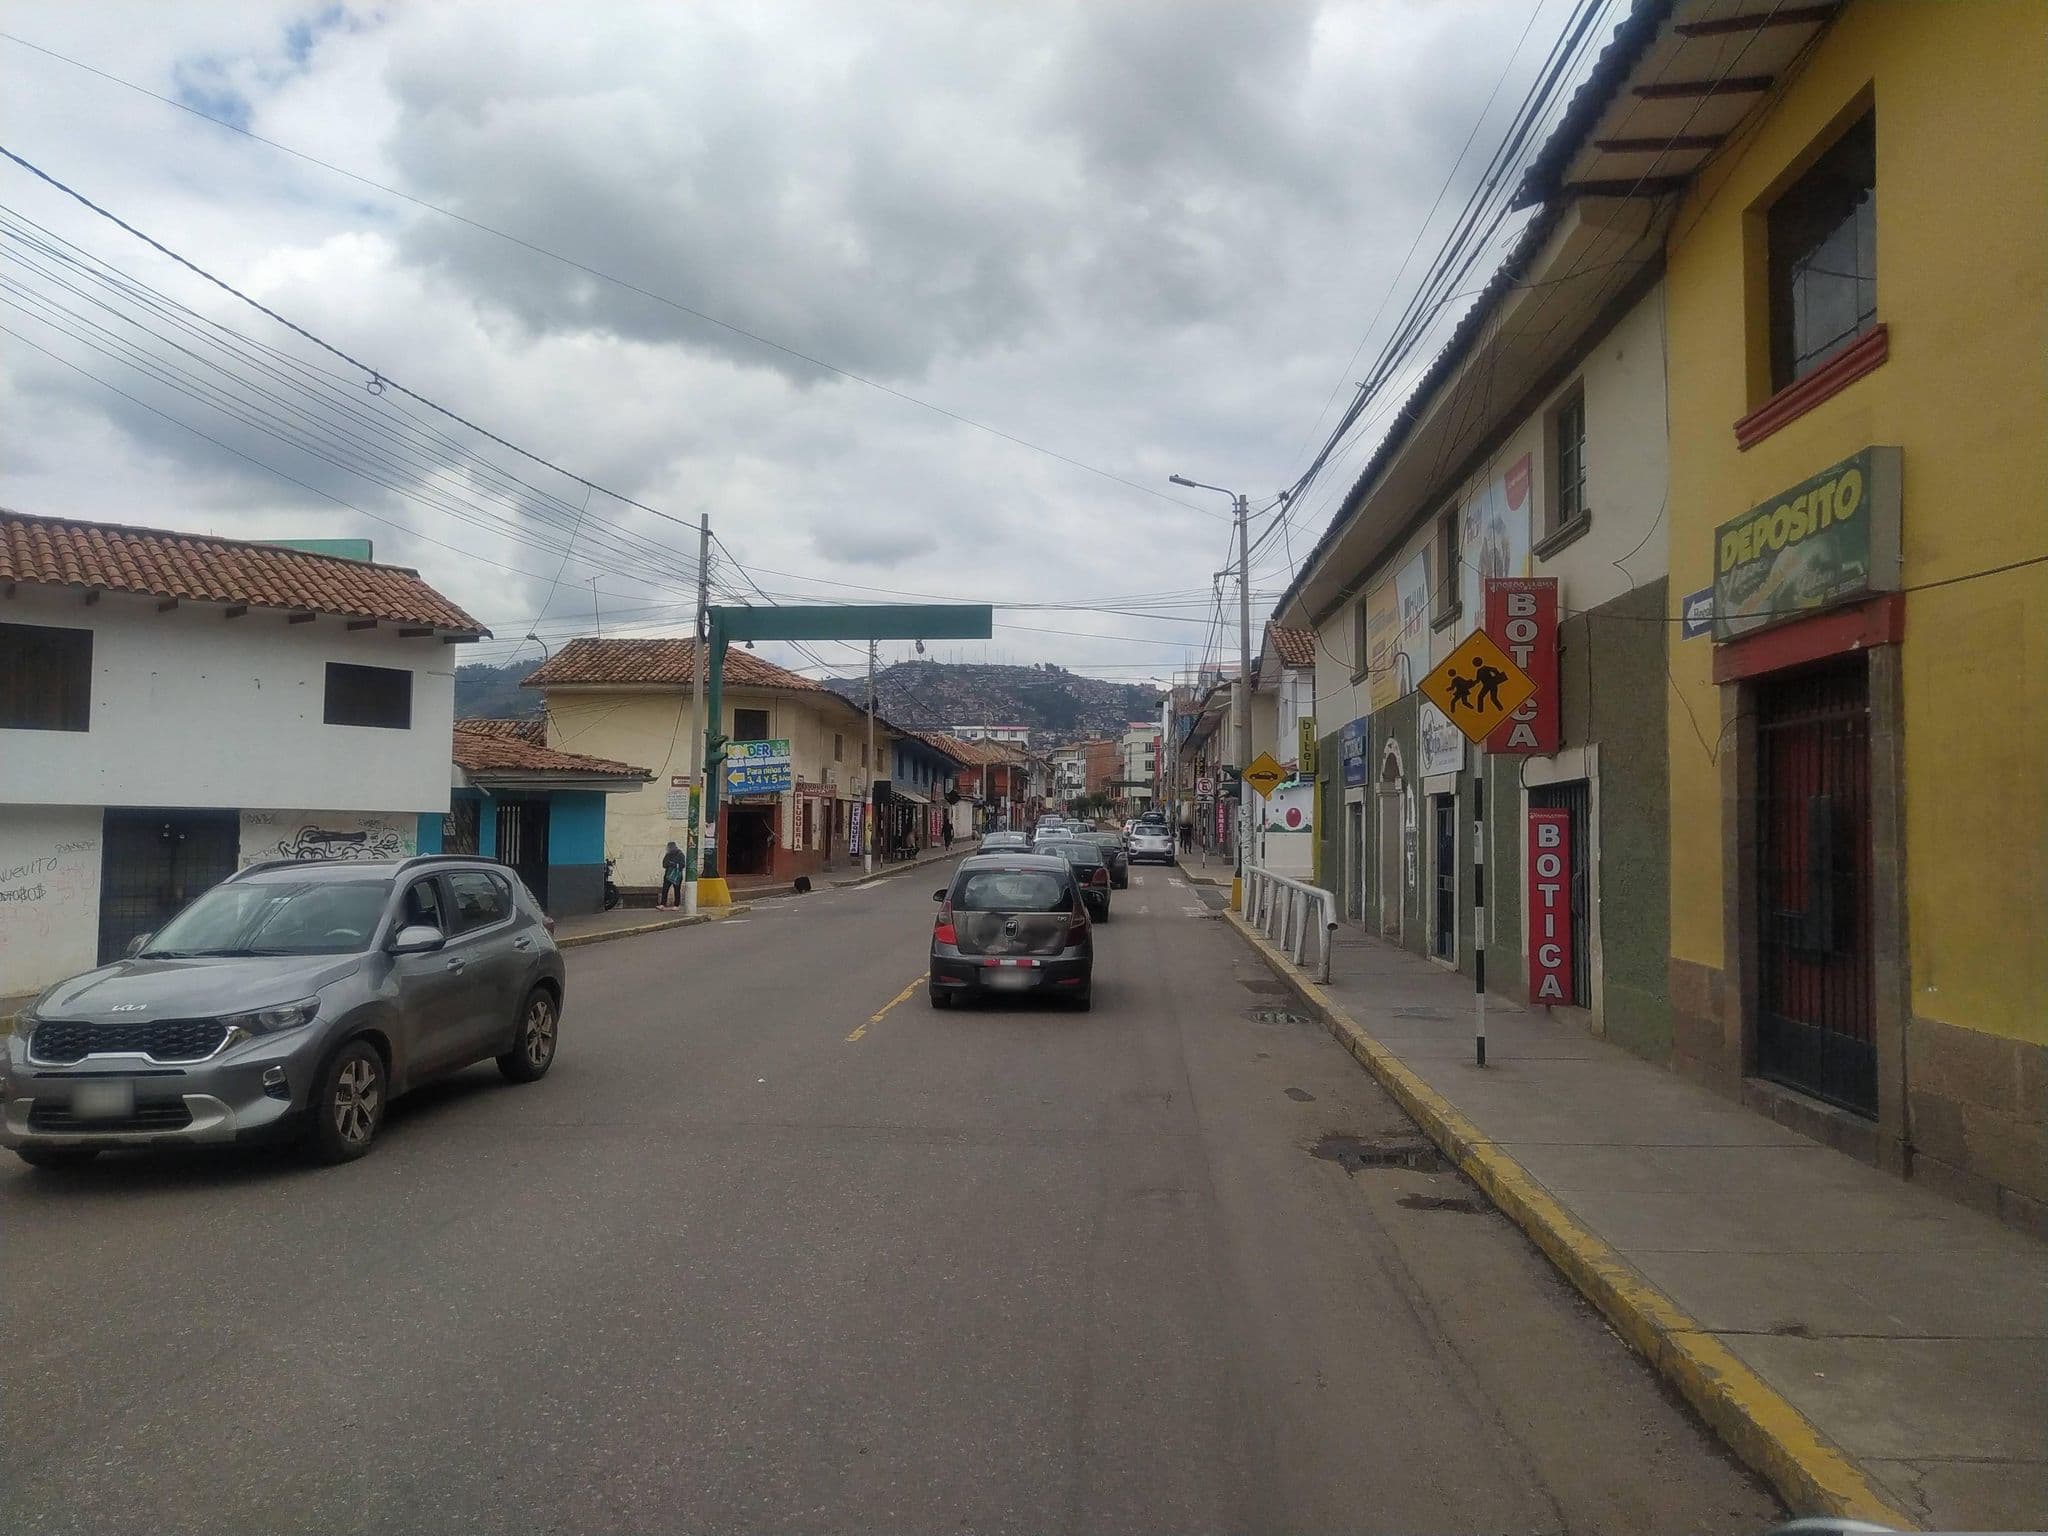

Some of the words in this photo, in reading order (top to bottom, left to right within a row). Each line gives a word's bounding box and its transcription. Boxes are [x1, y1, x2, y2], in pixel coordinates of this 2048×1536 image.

[1720, 468, 1862, 573] DEPOSITO
[1505, 593, 1539, 748] BOTCA
[772, 774, 778, 783] 5
[1303, 720, 1311, 771] bitel
[1536, 824, 1564, 999] BOTICA
